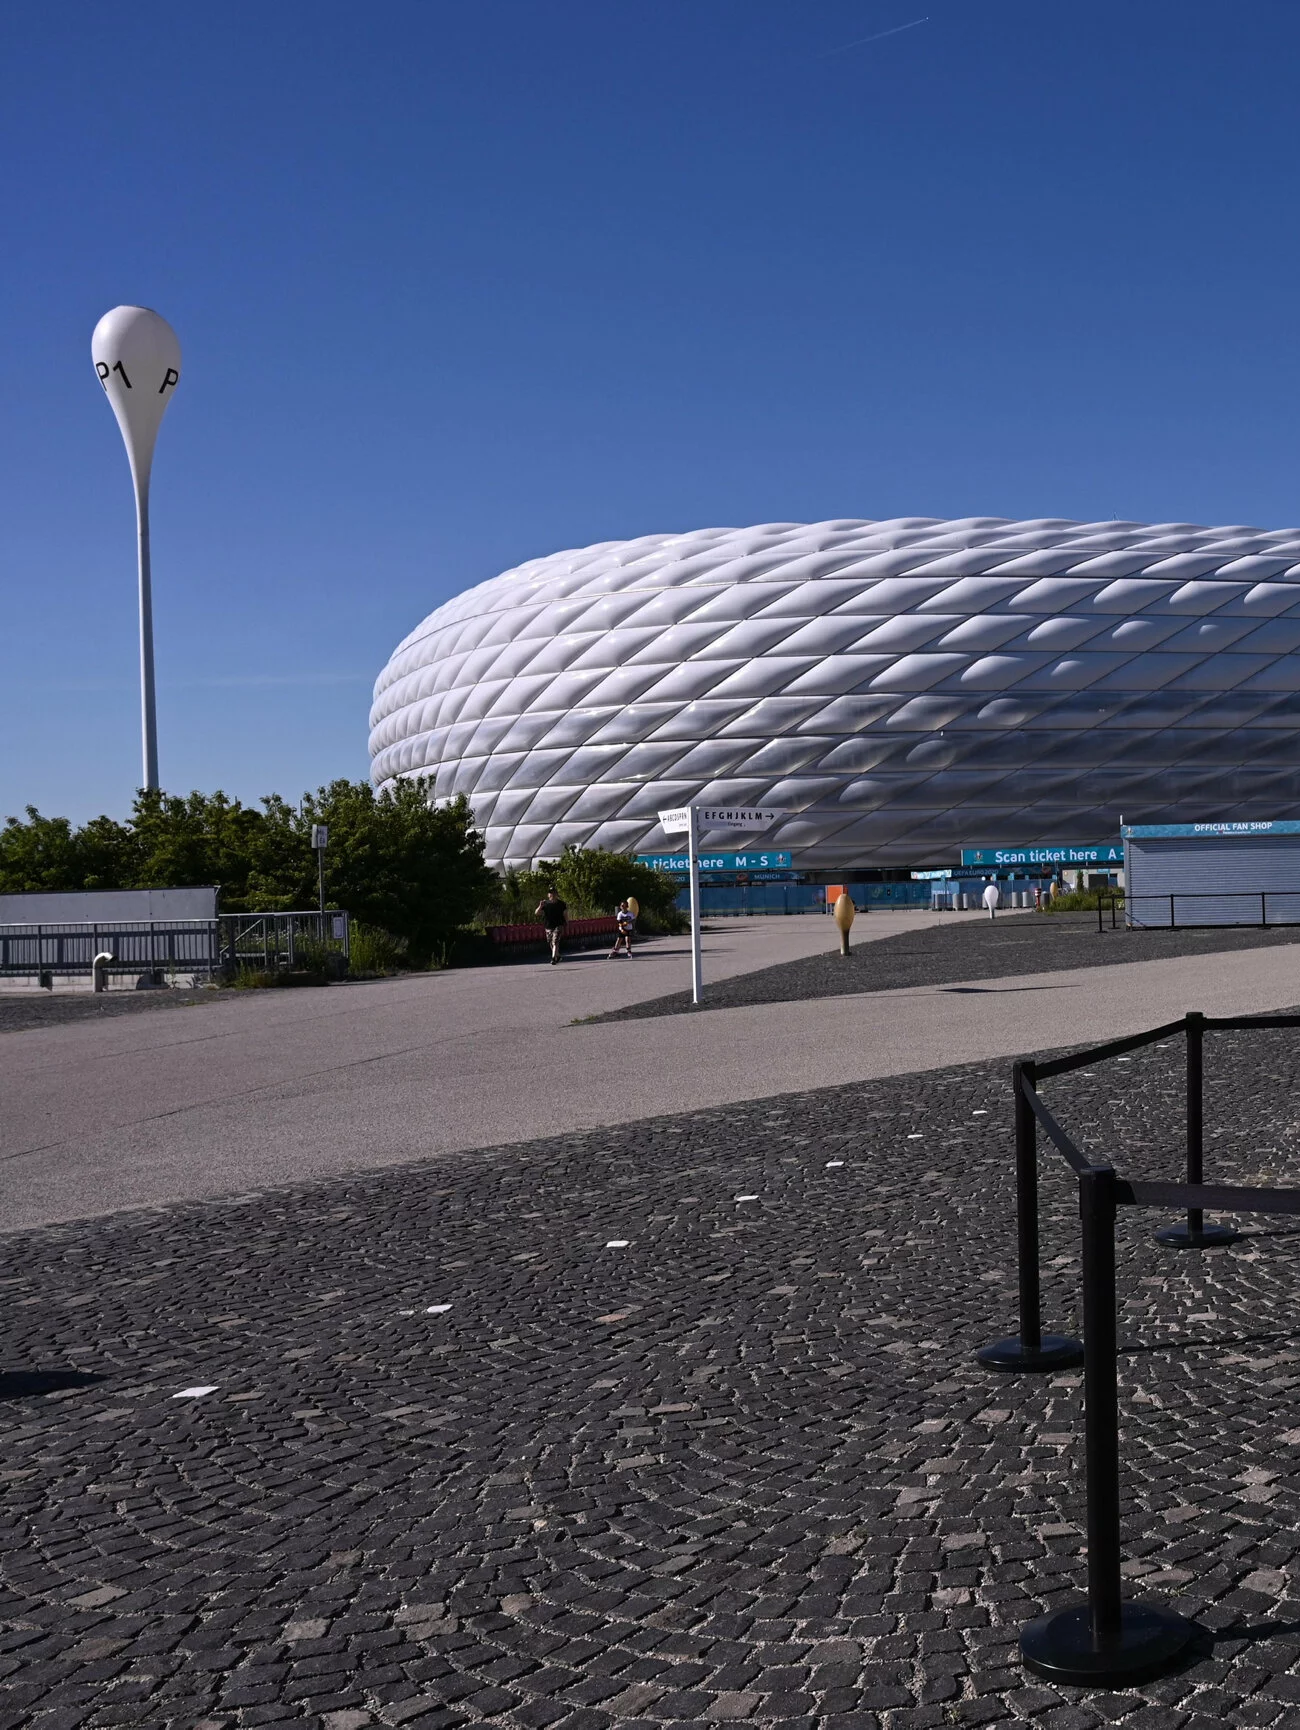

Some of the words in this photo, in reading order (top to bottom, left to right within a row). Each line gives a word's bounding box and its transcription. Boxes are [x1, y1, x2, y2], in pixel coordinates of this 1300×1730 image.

[96, 360, 132, 391] P1
[1194, 823, 1231, 832] OFFICIAL
[1232, 822, 1249, 830] FAN
[1250, 821, 1273, 830] SHOP
[995, 851, 1026, 863] Scan
[1029, 849, 1066, 862] ticket
[1069, 847, 1097, 860] here
[1108, 850, 1117, 860] A
[652, 858, 690, 871] ticket
[735, 857, 747, 867] M
[760, 856, 769, 867] S
